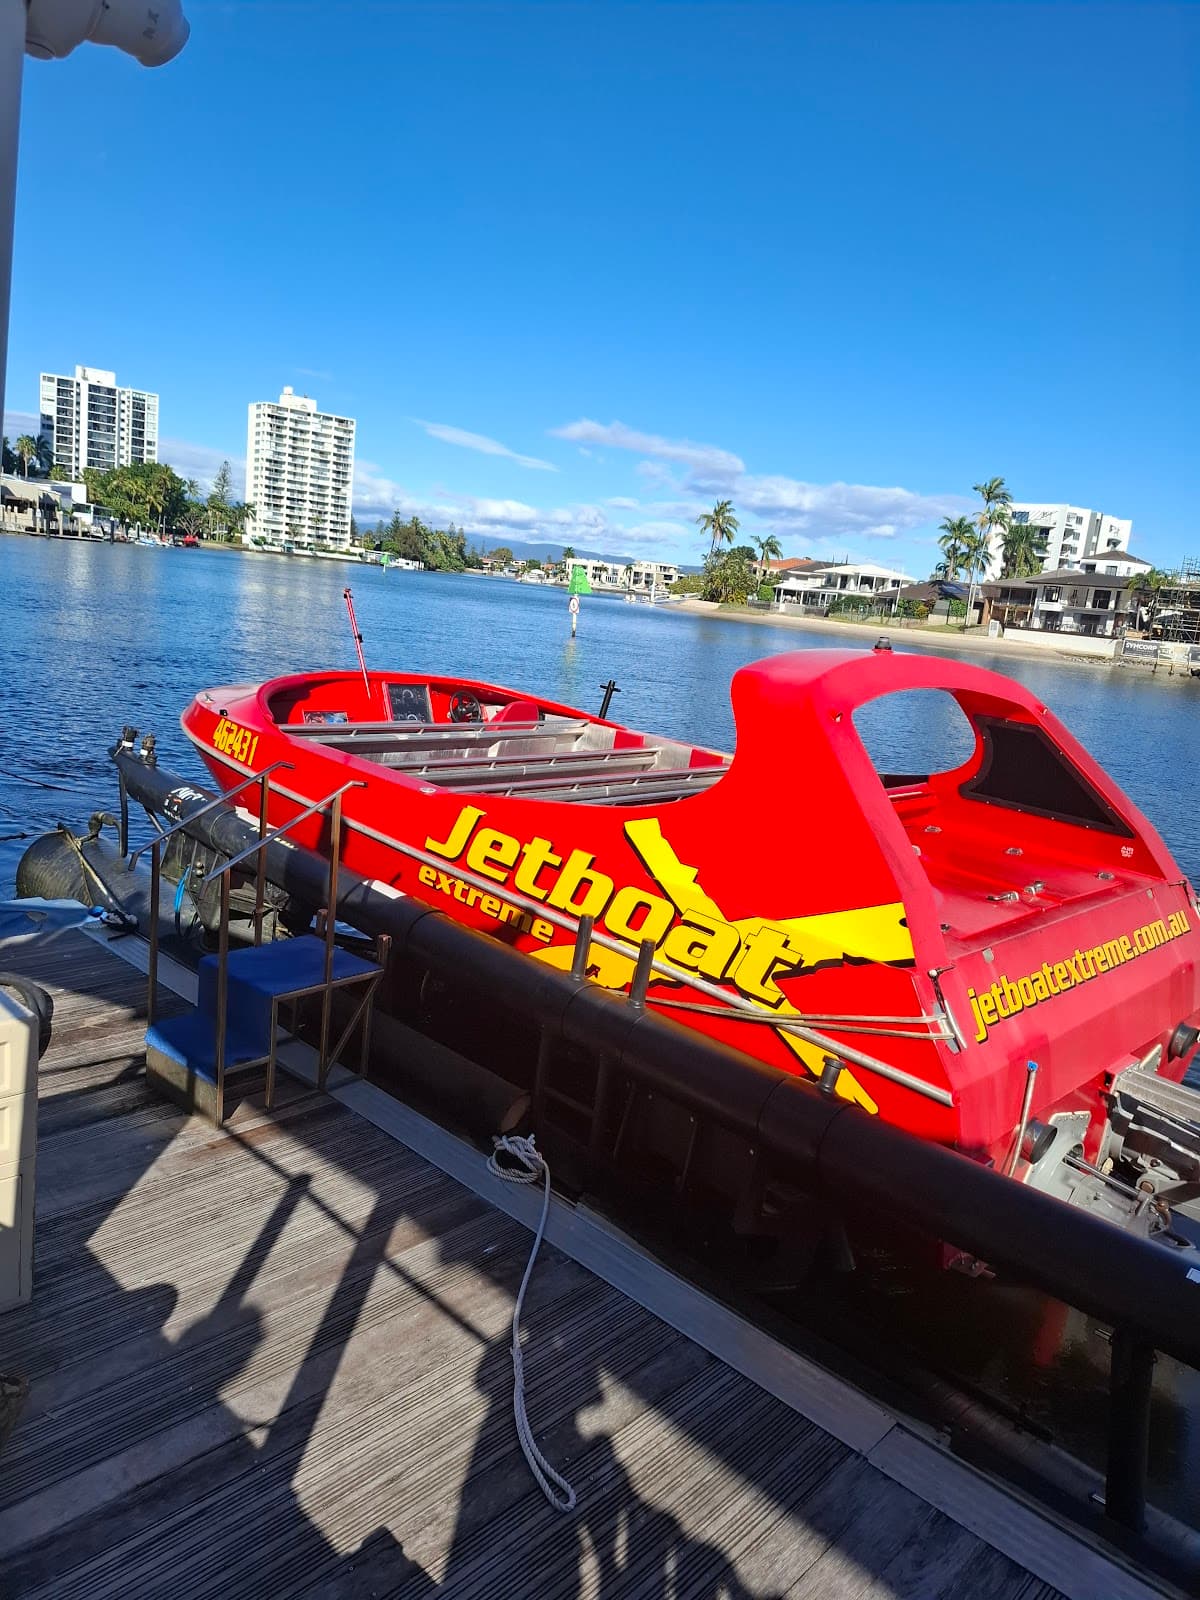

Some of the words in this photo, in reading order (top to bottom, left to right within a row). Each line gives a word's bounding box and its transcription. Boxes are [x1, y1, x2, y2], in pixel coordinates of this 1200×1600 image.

[418, 864, 554, 943] extreme
[424, 804, 803, 1009] Jetboat
[967, 910, 1191, 1042] jetboatextreme.com.au
